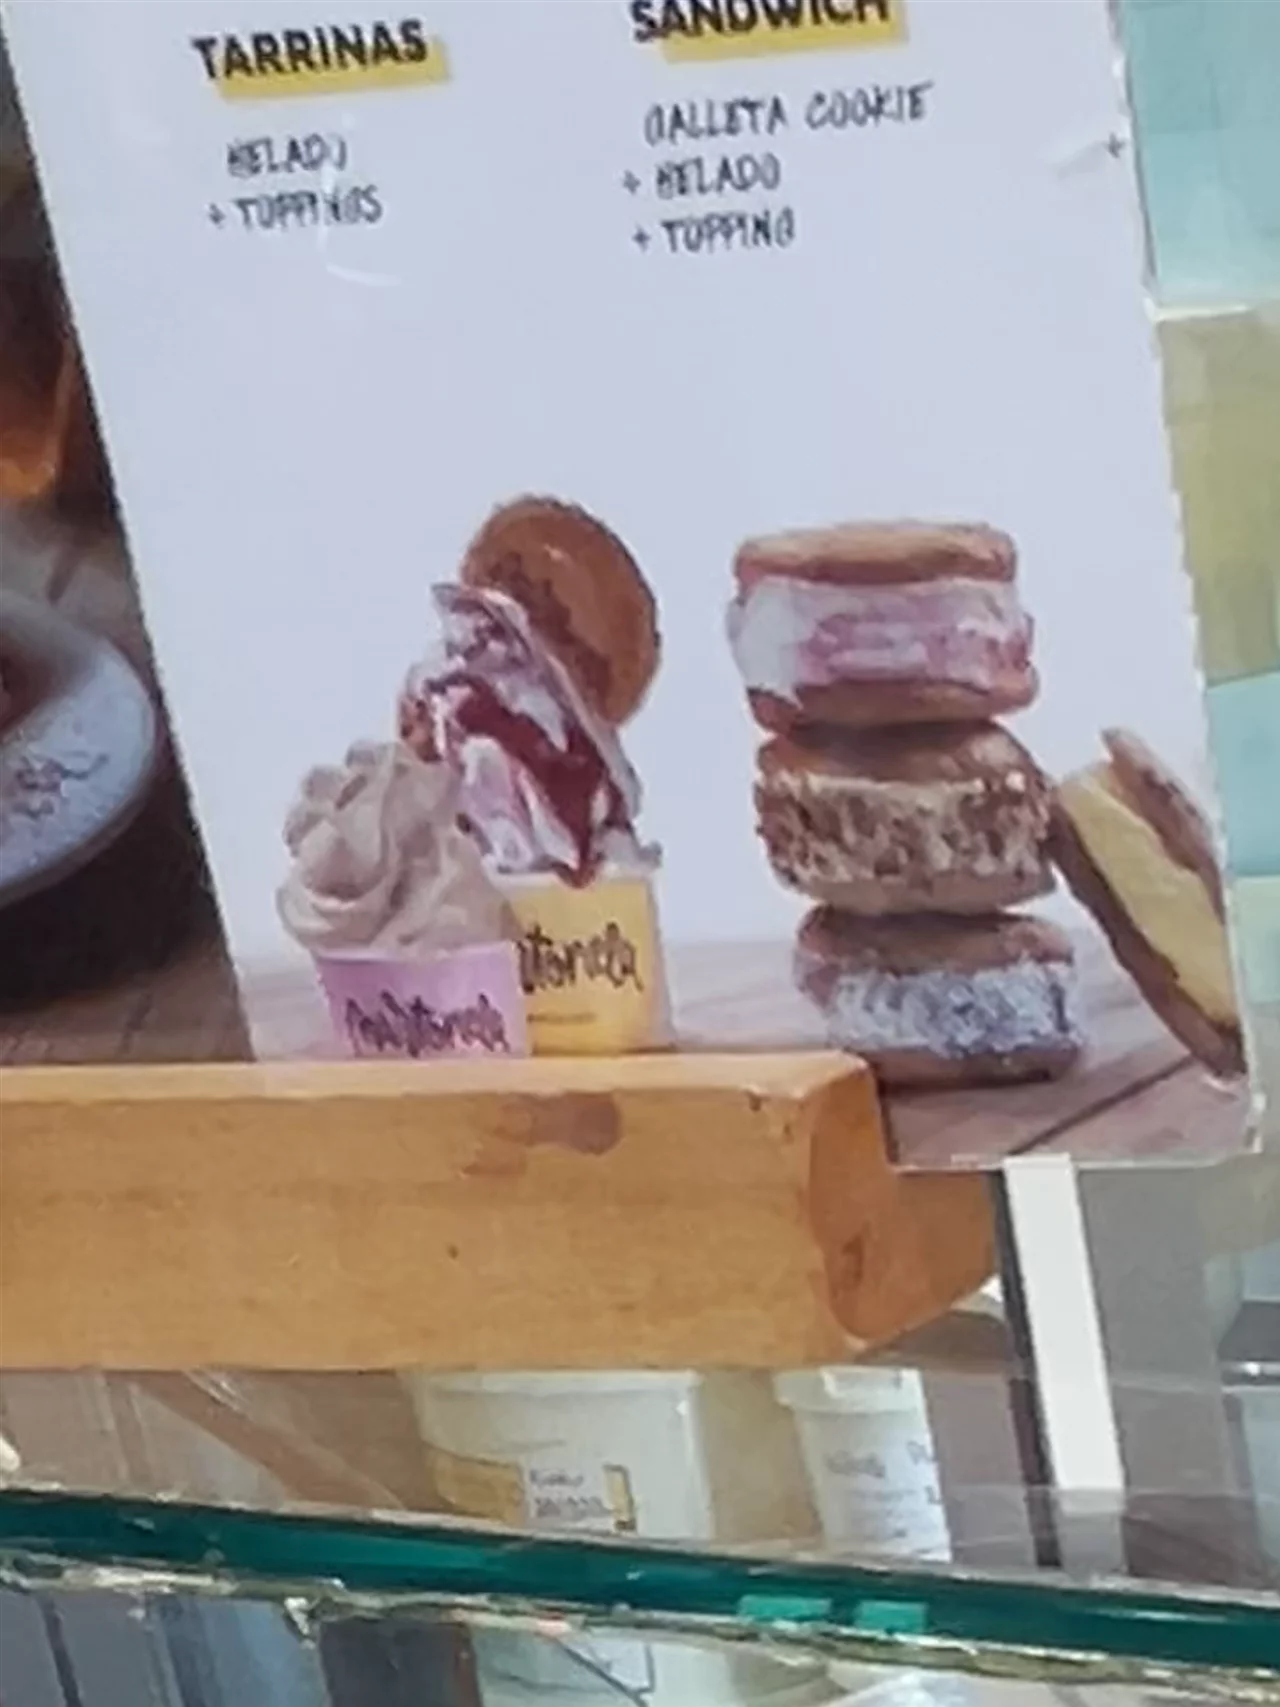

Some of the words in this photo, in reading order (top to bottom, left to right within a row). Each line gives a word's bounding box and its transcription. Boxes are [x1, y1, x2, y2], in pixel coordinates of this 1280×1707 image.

[630, 0, 890, 43] SANDWICH
[191, 18, 428, 80] TARRINAS
[805, 81, 934, 130] COOKIE
[656, 153, 781, 200] HELADO
